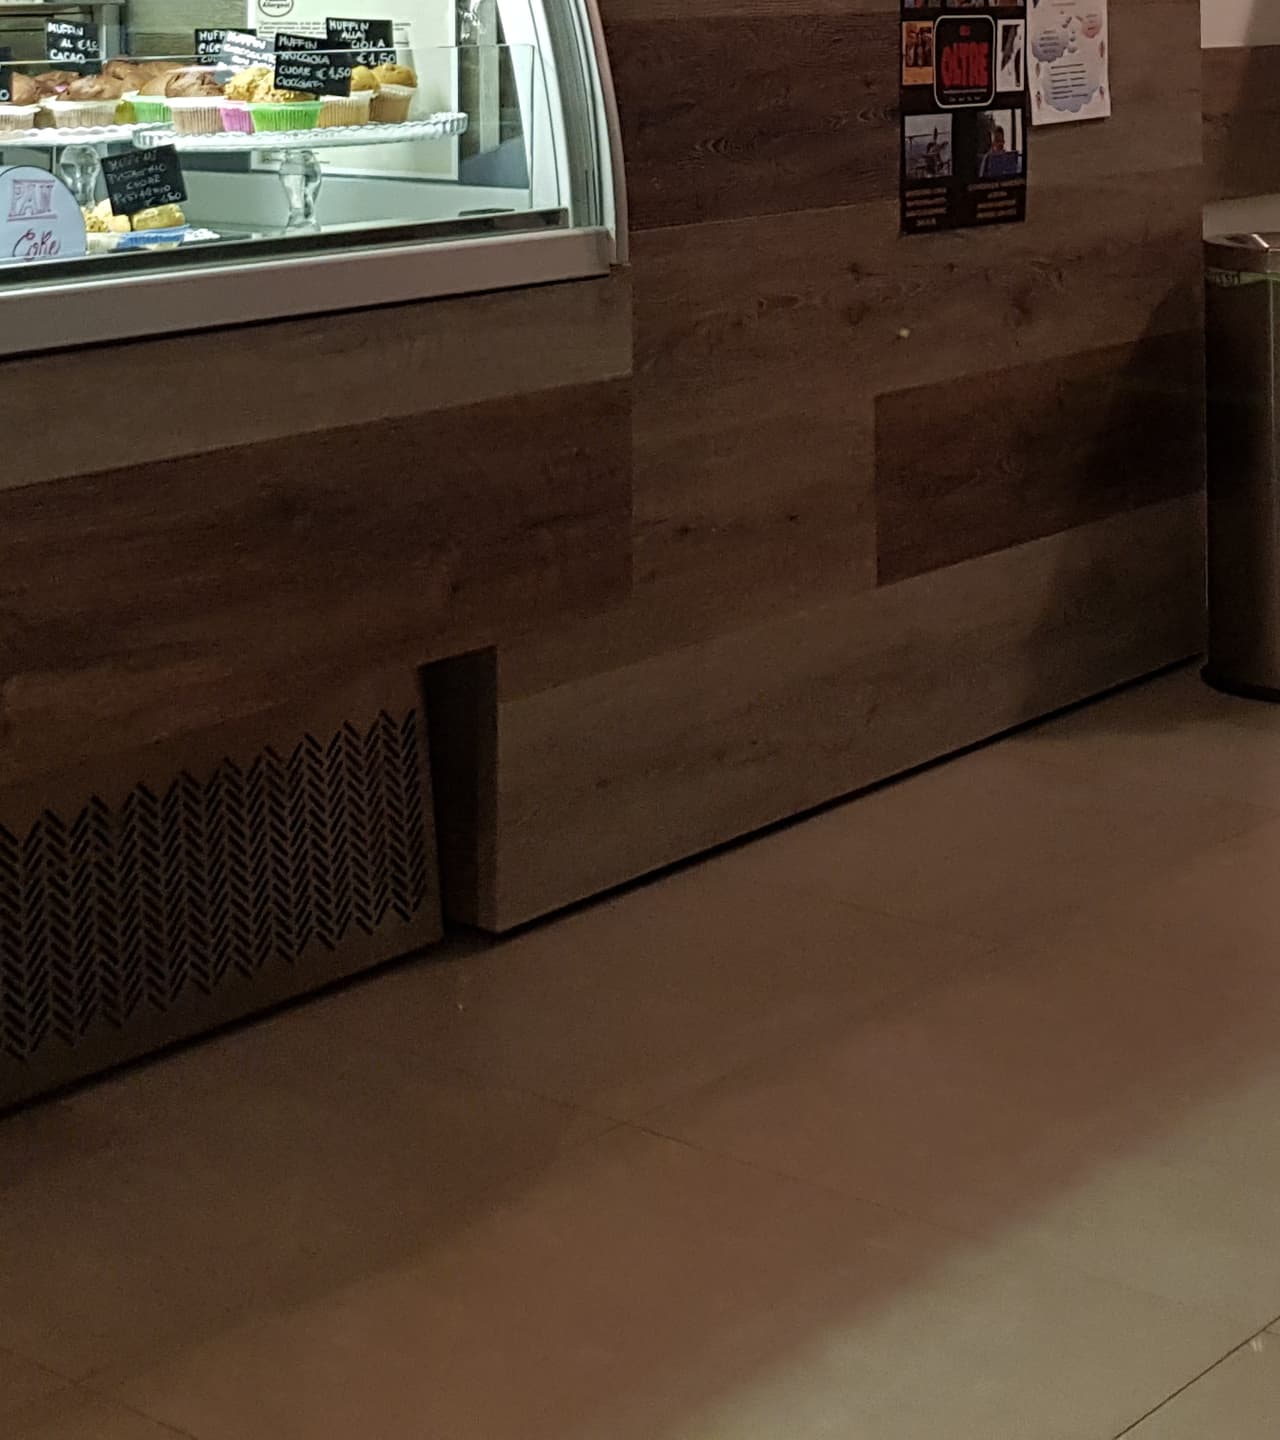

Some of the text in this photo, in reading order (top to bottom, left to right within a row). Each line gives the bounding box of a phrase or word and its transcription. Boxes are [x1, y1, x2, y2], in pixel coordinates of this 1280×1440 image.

[47, 22, 84, 36] MUFFIN
[328, 20, 369, 31] MUFFIN
[278, 36, 317, 50] MUFFIN
[50, 49, 86, 64] CACAO
